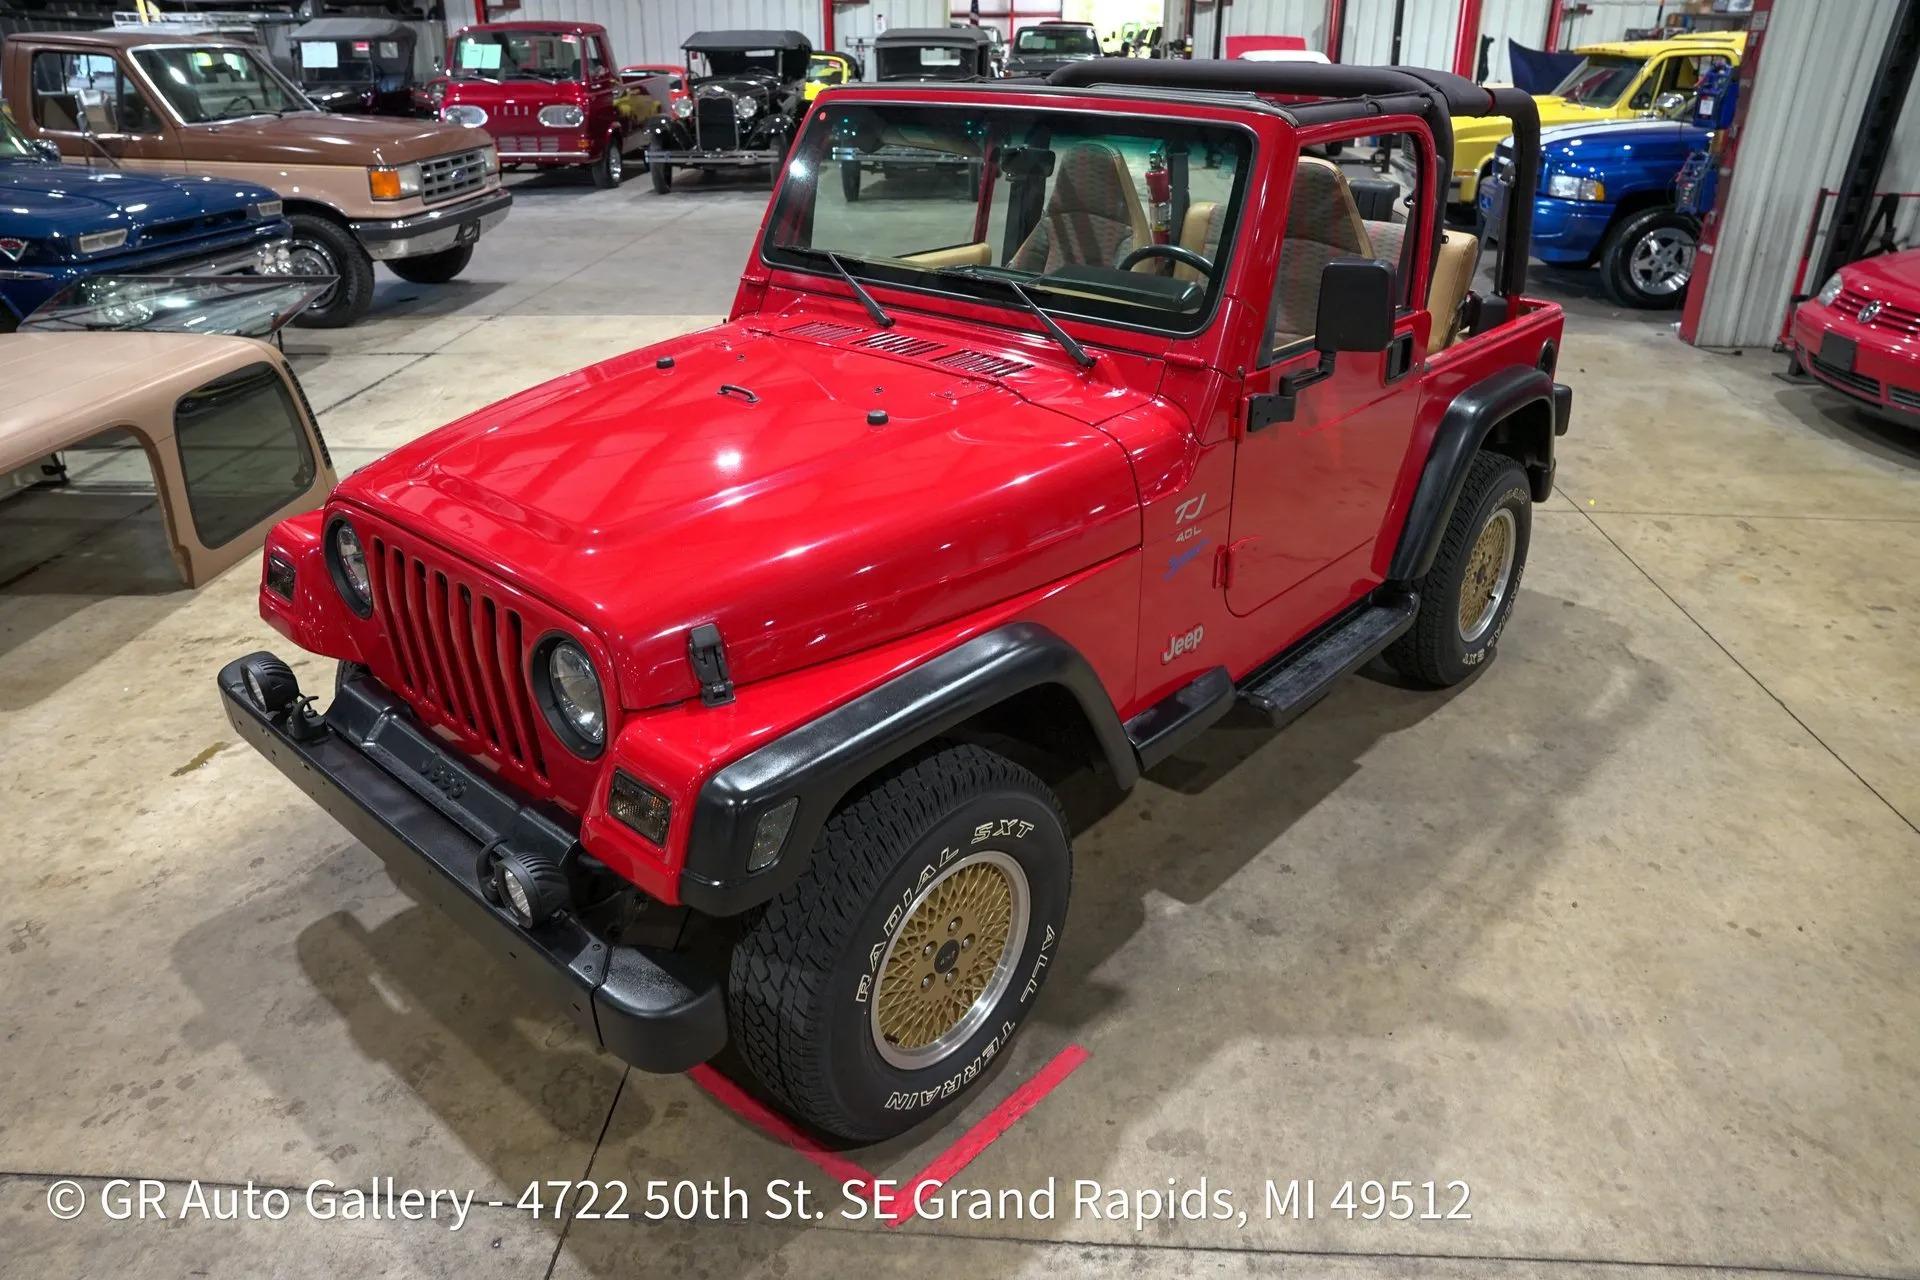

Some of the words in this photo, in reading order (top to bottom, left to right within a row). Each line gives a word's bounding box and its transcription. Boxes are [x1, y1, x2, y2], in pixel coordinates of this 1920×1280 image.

[1175, 493, 1207, 525] TJ
[1163, 624, 1204, 664] Jeep
[855, 846, 959, 1003] RADIAL
[970, 818, 1035, 845] SXT
[1020, 924, 1056, 1003] ALL
[884, 1020, 1016, 1111] TERRAIN
